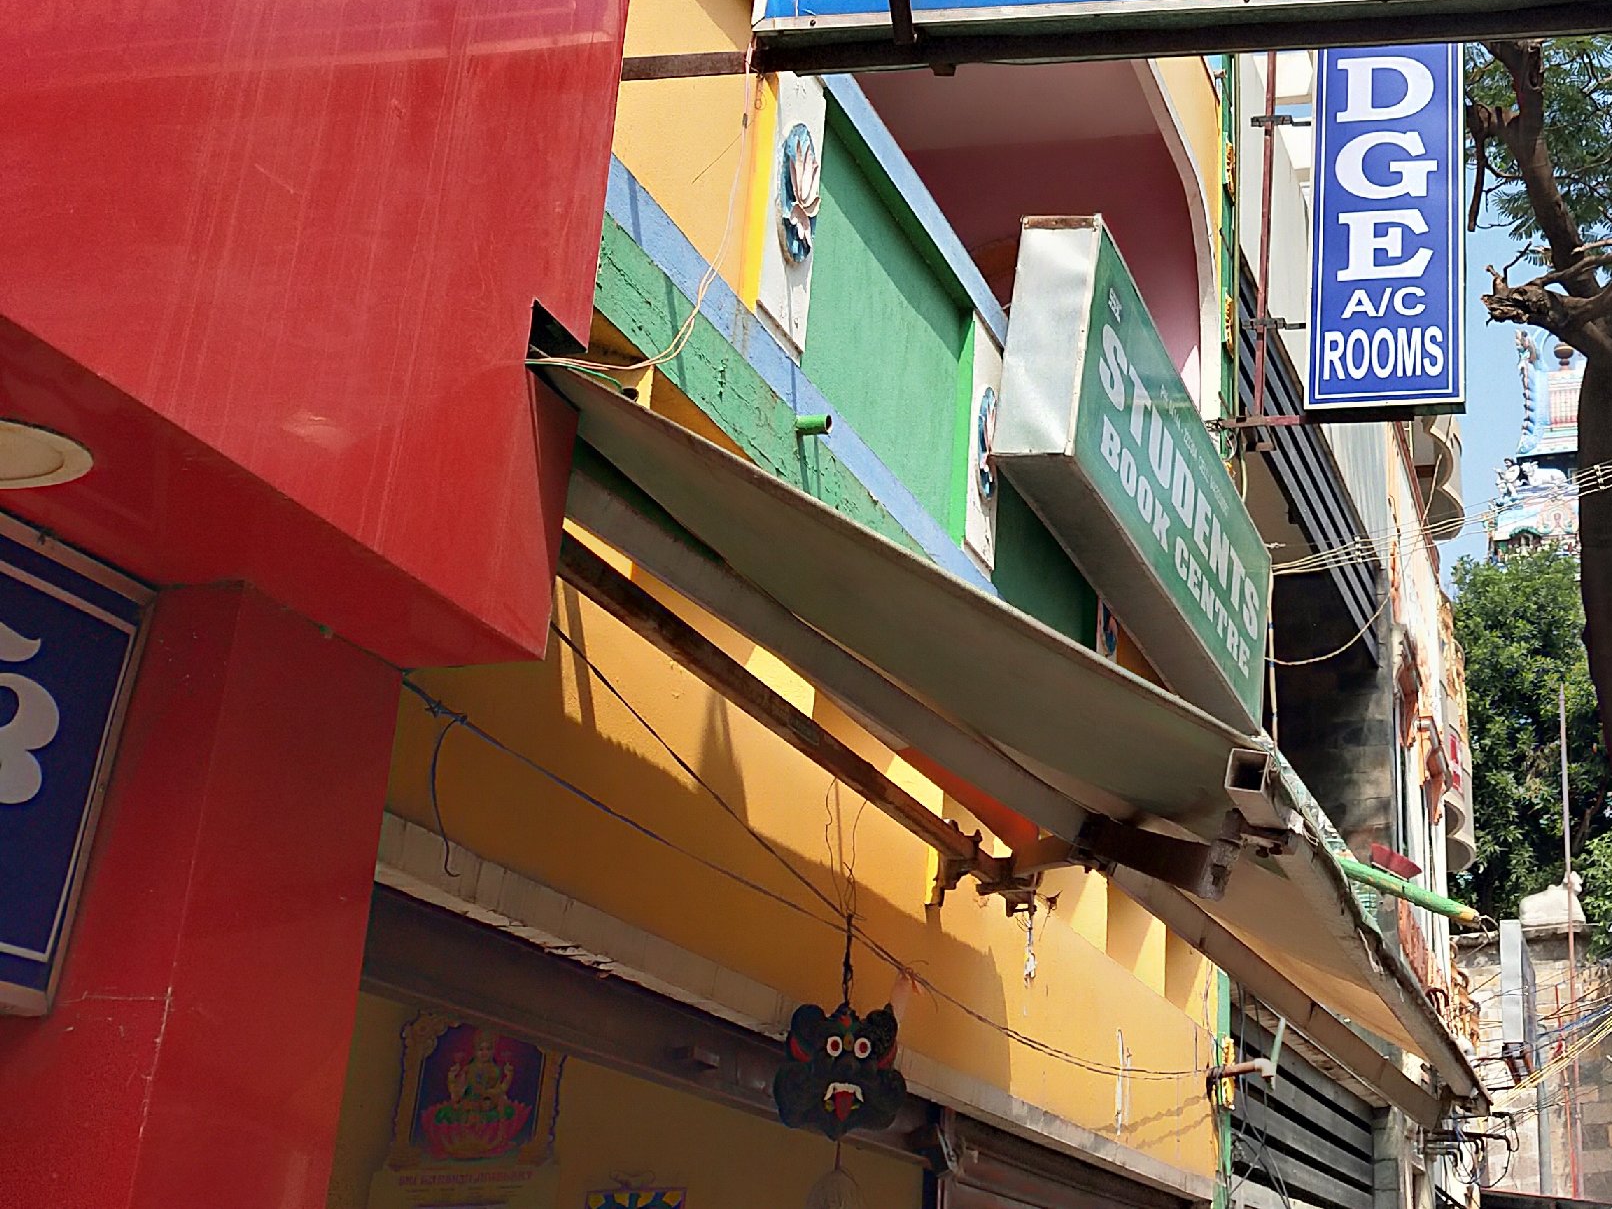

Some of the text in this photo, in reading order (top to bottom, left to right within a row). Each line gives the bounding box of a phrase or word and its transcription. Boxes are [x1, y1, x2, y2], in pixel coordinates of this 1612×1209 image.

[1322, 326, 1445, 382] ROOMS
[1342, 285, 1428, 321] A/C
[1098, 322, 1260, 641] STUDENTS
[1099, 413, 1171, 553] BOOK
[1173, 535, 1251, 679] CENTRE
